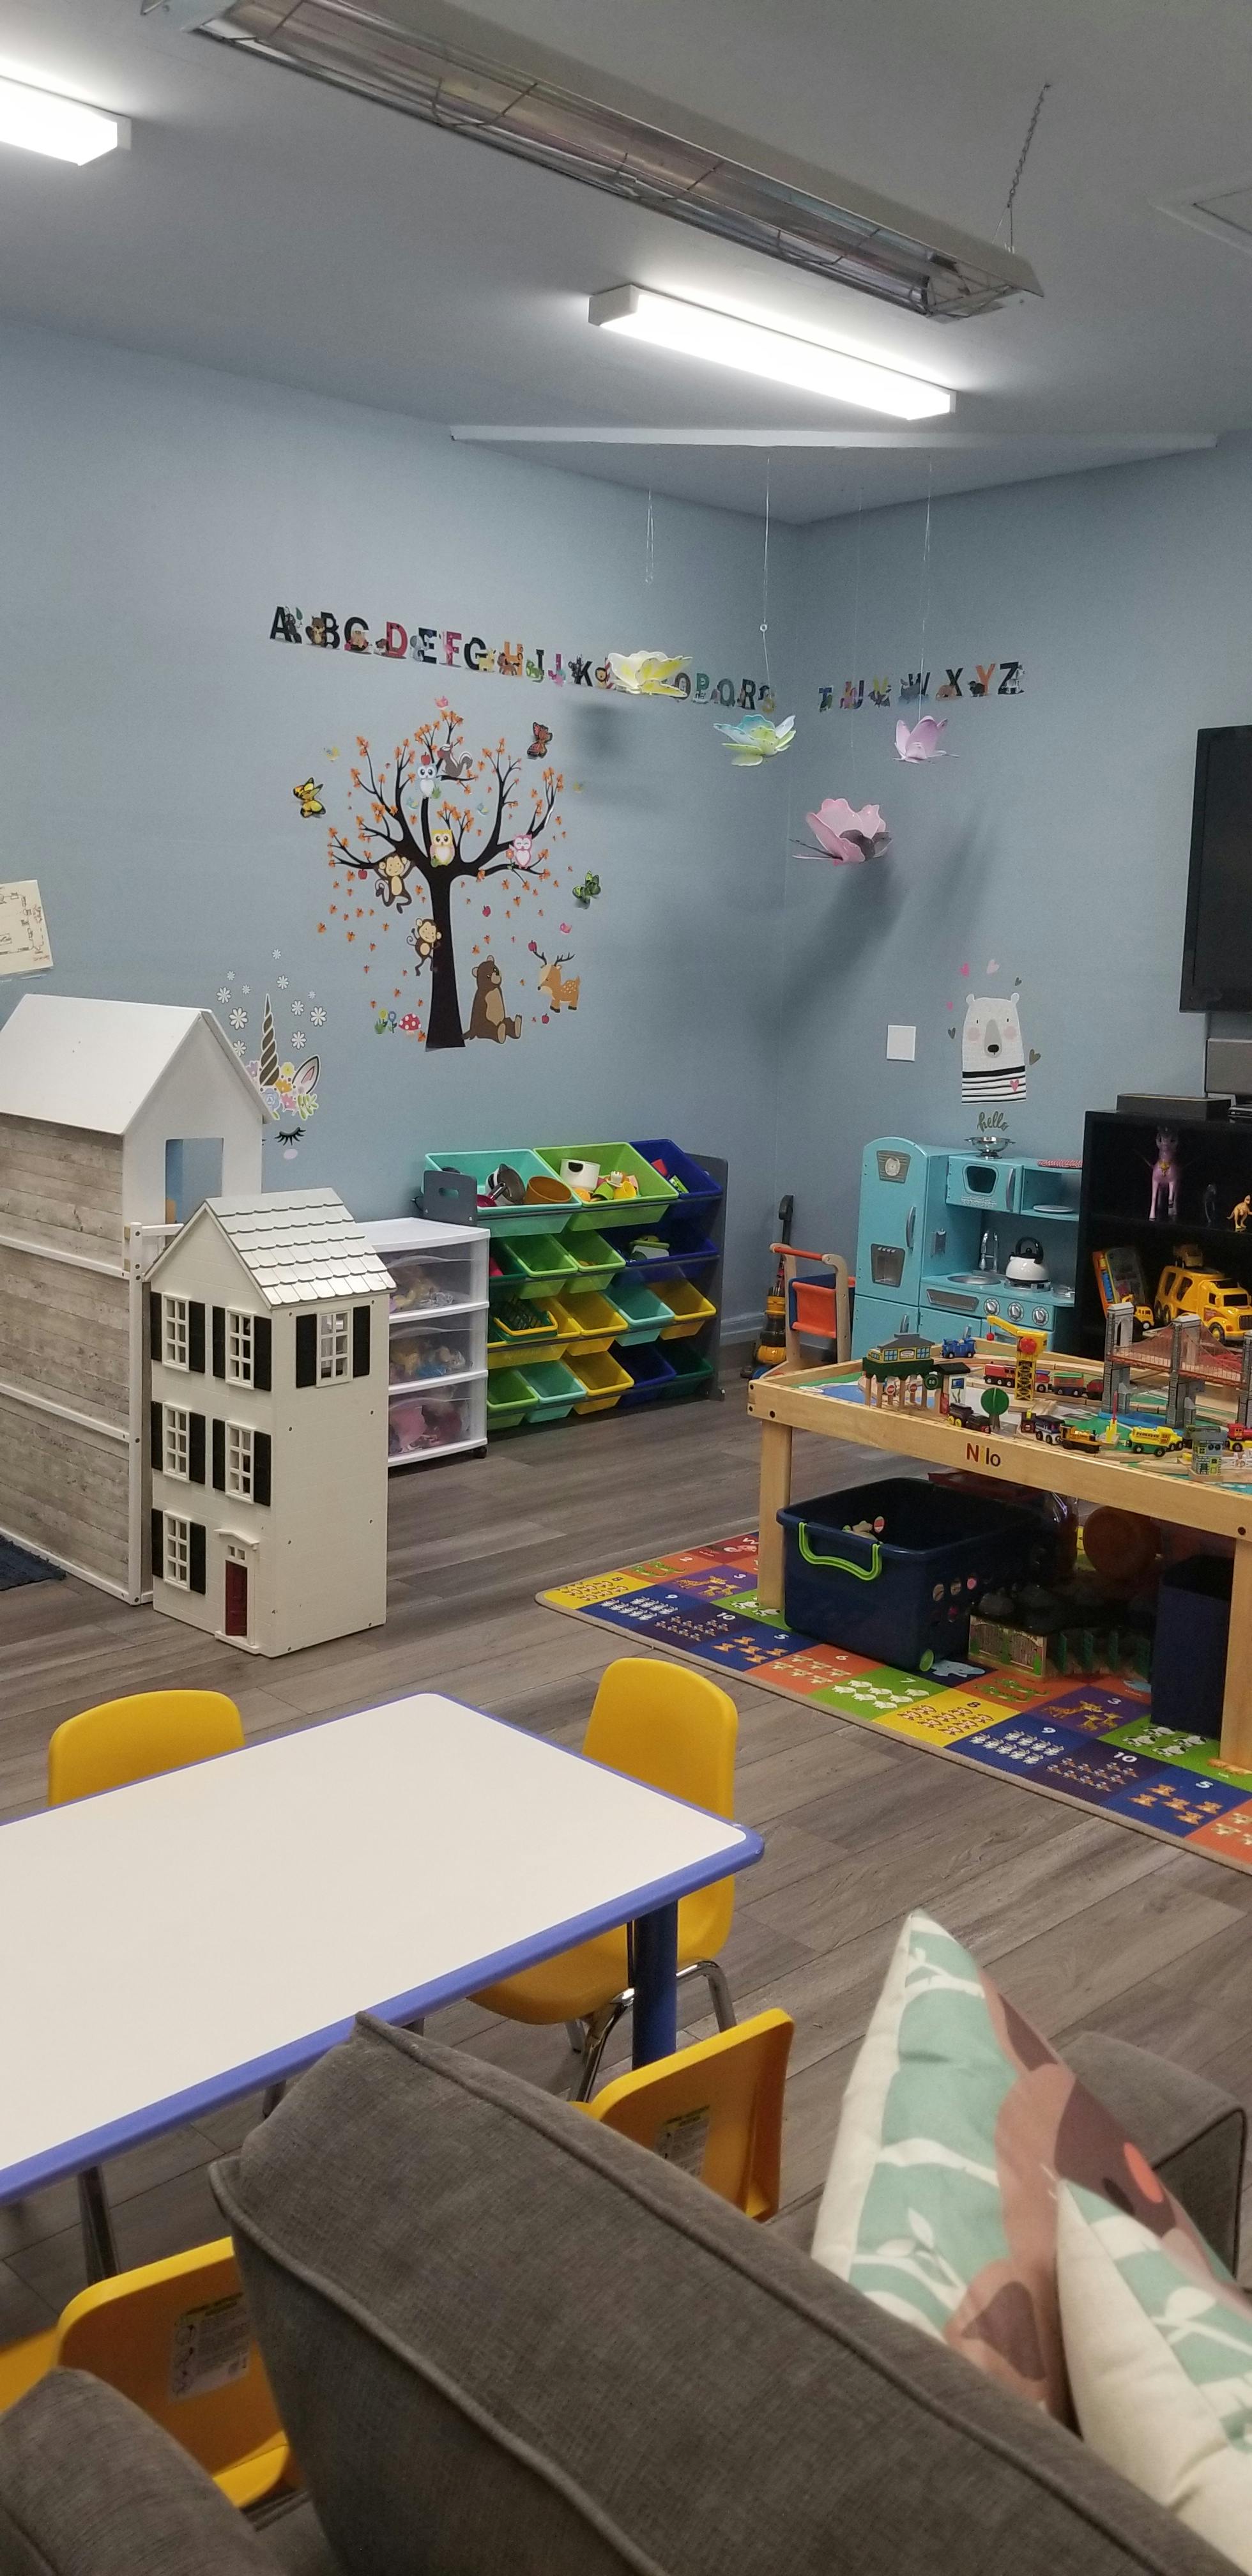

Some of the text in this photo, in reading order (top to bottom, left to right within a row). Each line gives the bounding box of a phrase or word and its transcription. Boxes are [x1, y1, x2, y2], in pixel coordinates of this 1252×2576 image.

[977, 1110, 1009, 1132] hello
[716, 1612, 736, 1620] 10
[1113, 1752, 1137, 1763] 10
